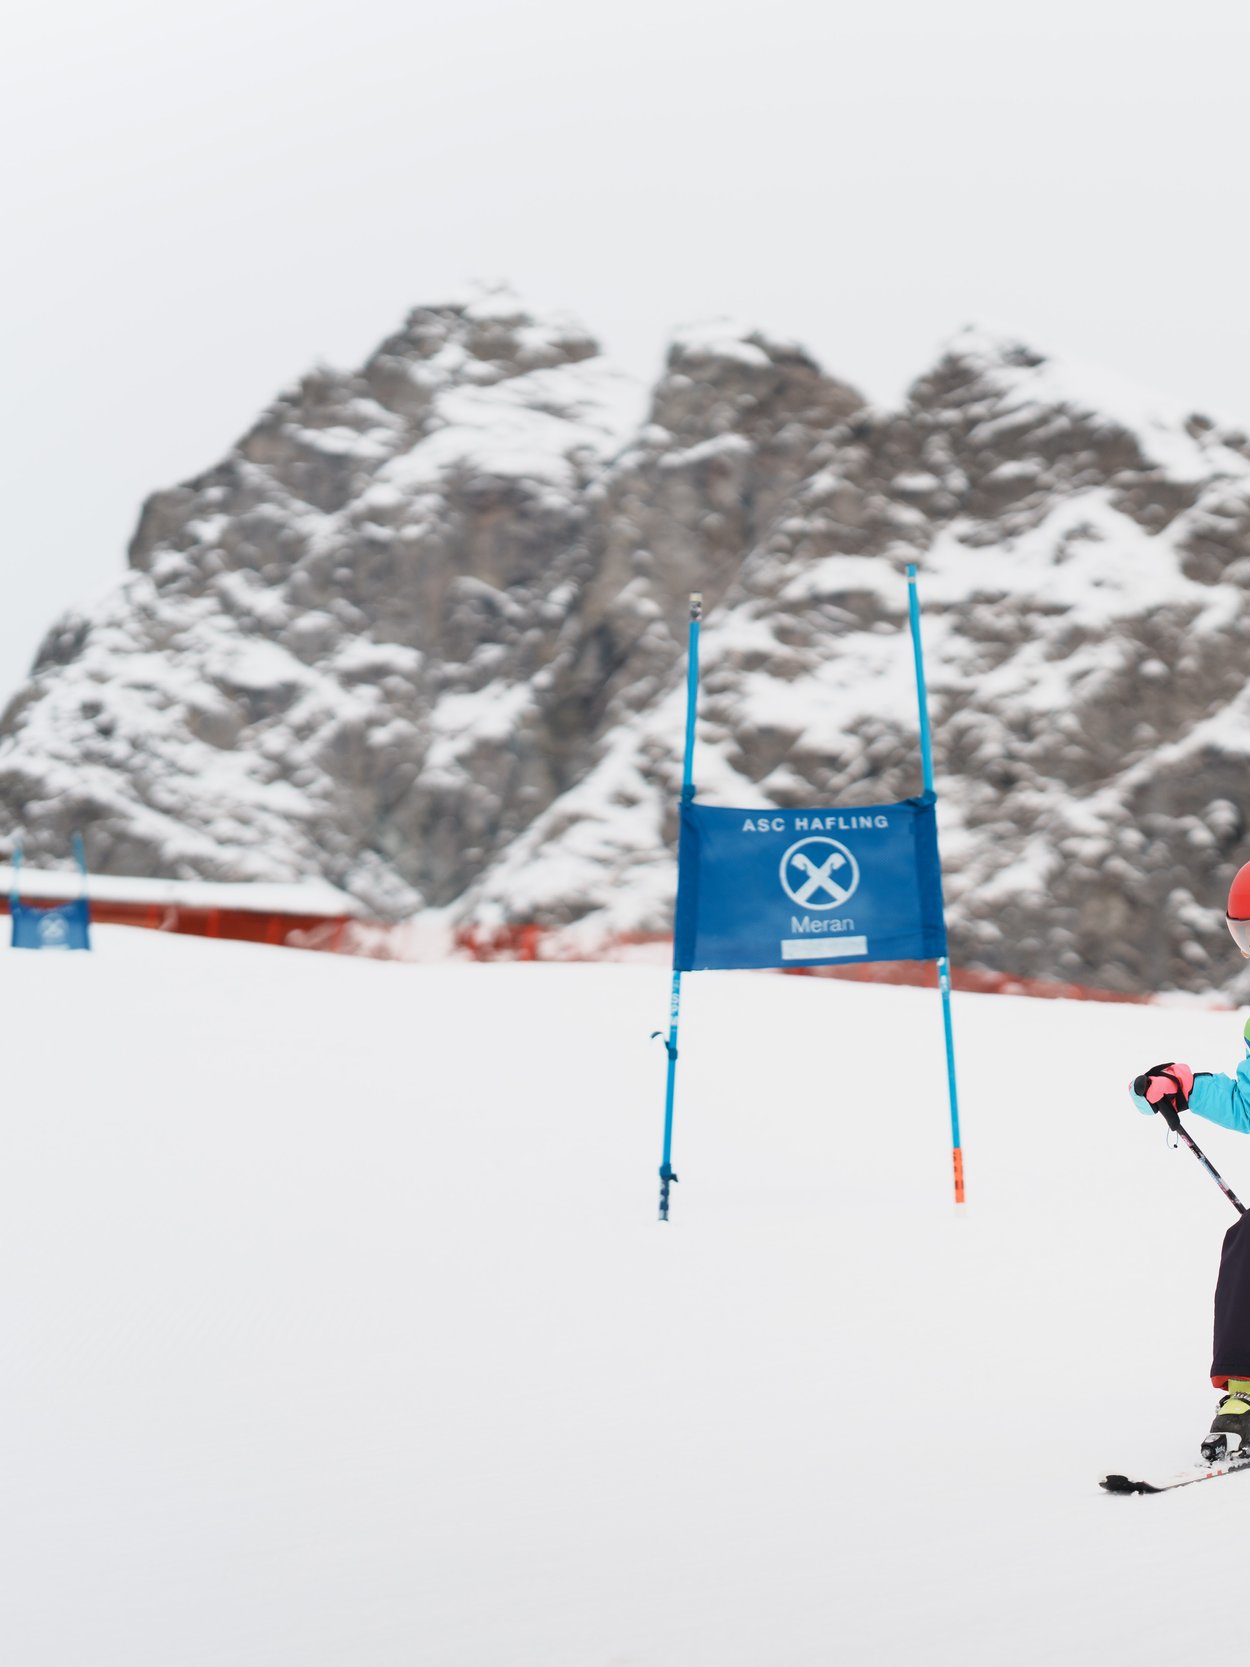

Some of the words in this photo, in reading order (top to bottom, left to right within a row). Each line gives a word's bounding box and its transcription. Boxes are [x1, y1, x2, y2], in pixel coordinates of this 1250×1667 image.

[742, 818, 785, 833] ASC
[795, 815, 889, 831] HAFLING
[790, 915, 855, 934] Meran
